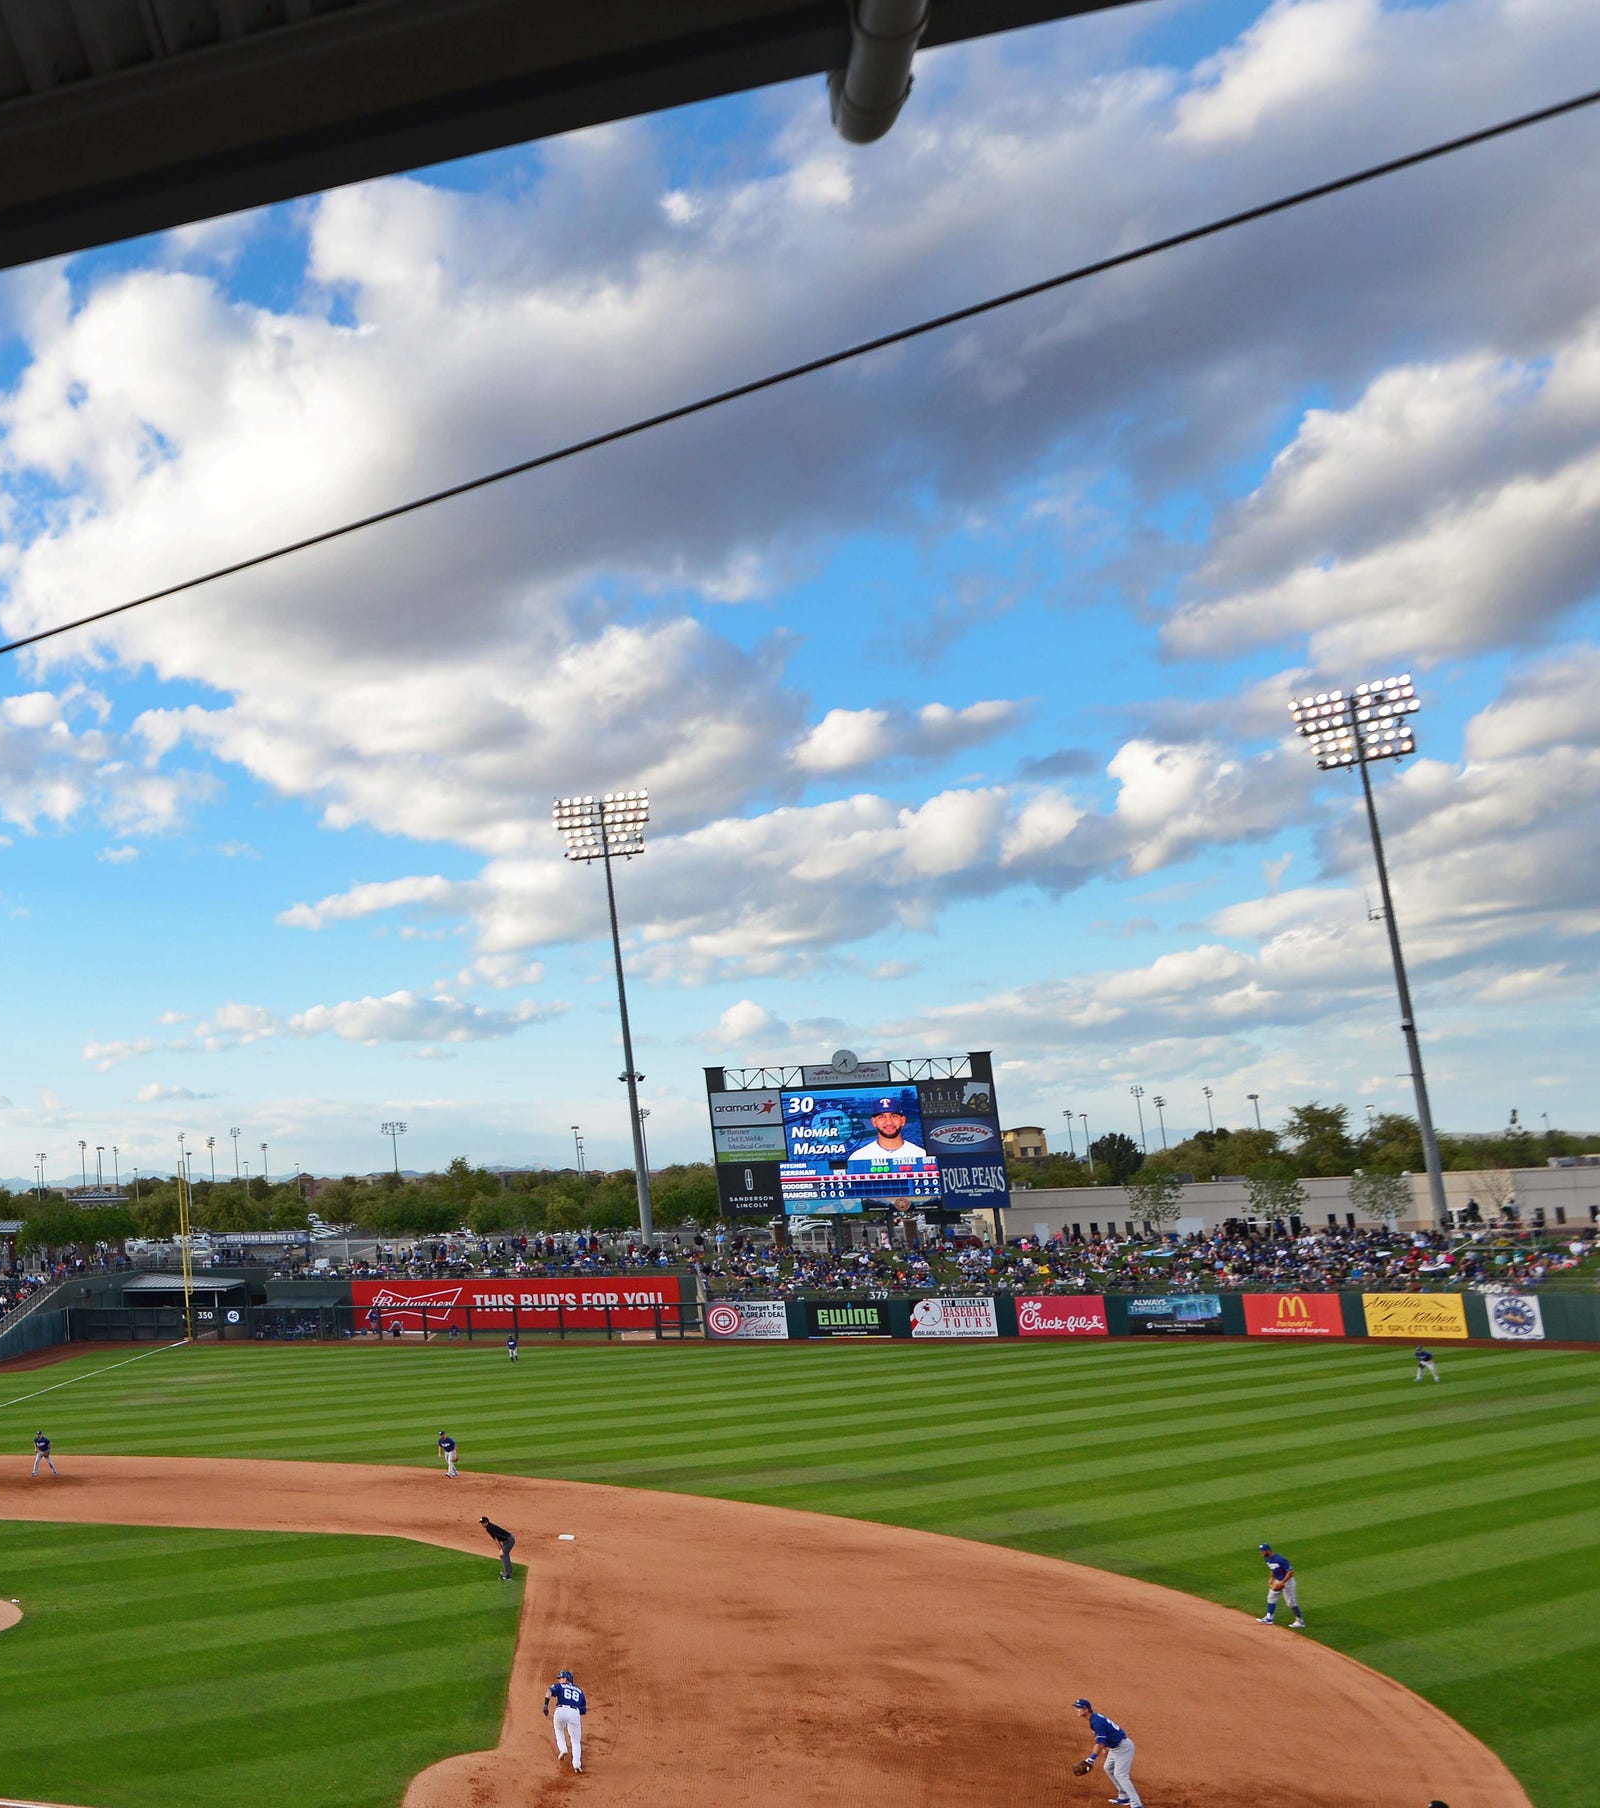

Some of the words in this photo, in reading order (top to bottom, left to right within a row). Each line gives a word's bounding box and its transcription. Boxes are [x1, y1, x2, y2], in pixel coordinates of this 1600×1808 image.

[714, 1103, 760, 1113] aramark
[788, 1096, 814, 1114] 30
[791, 1126, 838, 1139] NOMAR
[933, 1126, 989, 1138] SANDERSON
[948, 1132, 976, 1143] Ford
[793, 1143, 847, 1155] MAZARA
[941, 1168, 970, 1193] FOUR
[971, 1166, 1006, 1192] PEAKS
[869, 1291, 888, 1299] 379
[372, 1296, 454, 1311] Budweiser
[473, 1295, 515, 1312] THIS
[520, 1294, 577, 1311] BUD'S
[582, 1293, 620, 1311] FOR
[623, 1292, 670, 1310] YOU.
[943, 1306, 990, 1317] BASEBALL
[944, 1317, 992, 1328] TOURS
[1020, 1308, 1104, 1332] Chick-fil-A
[564, 1689, 579, 1702] 68
